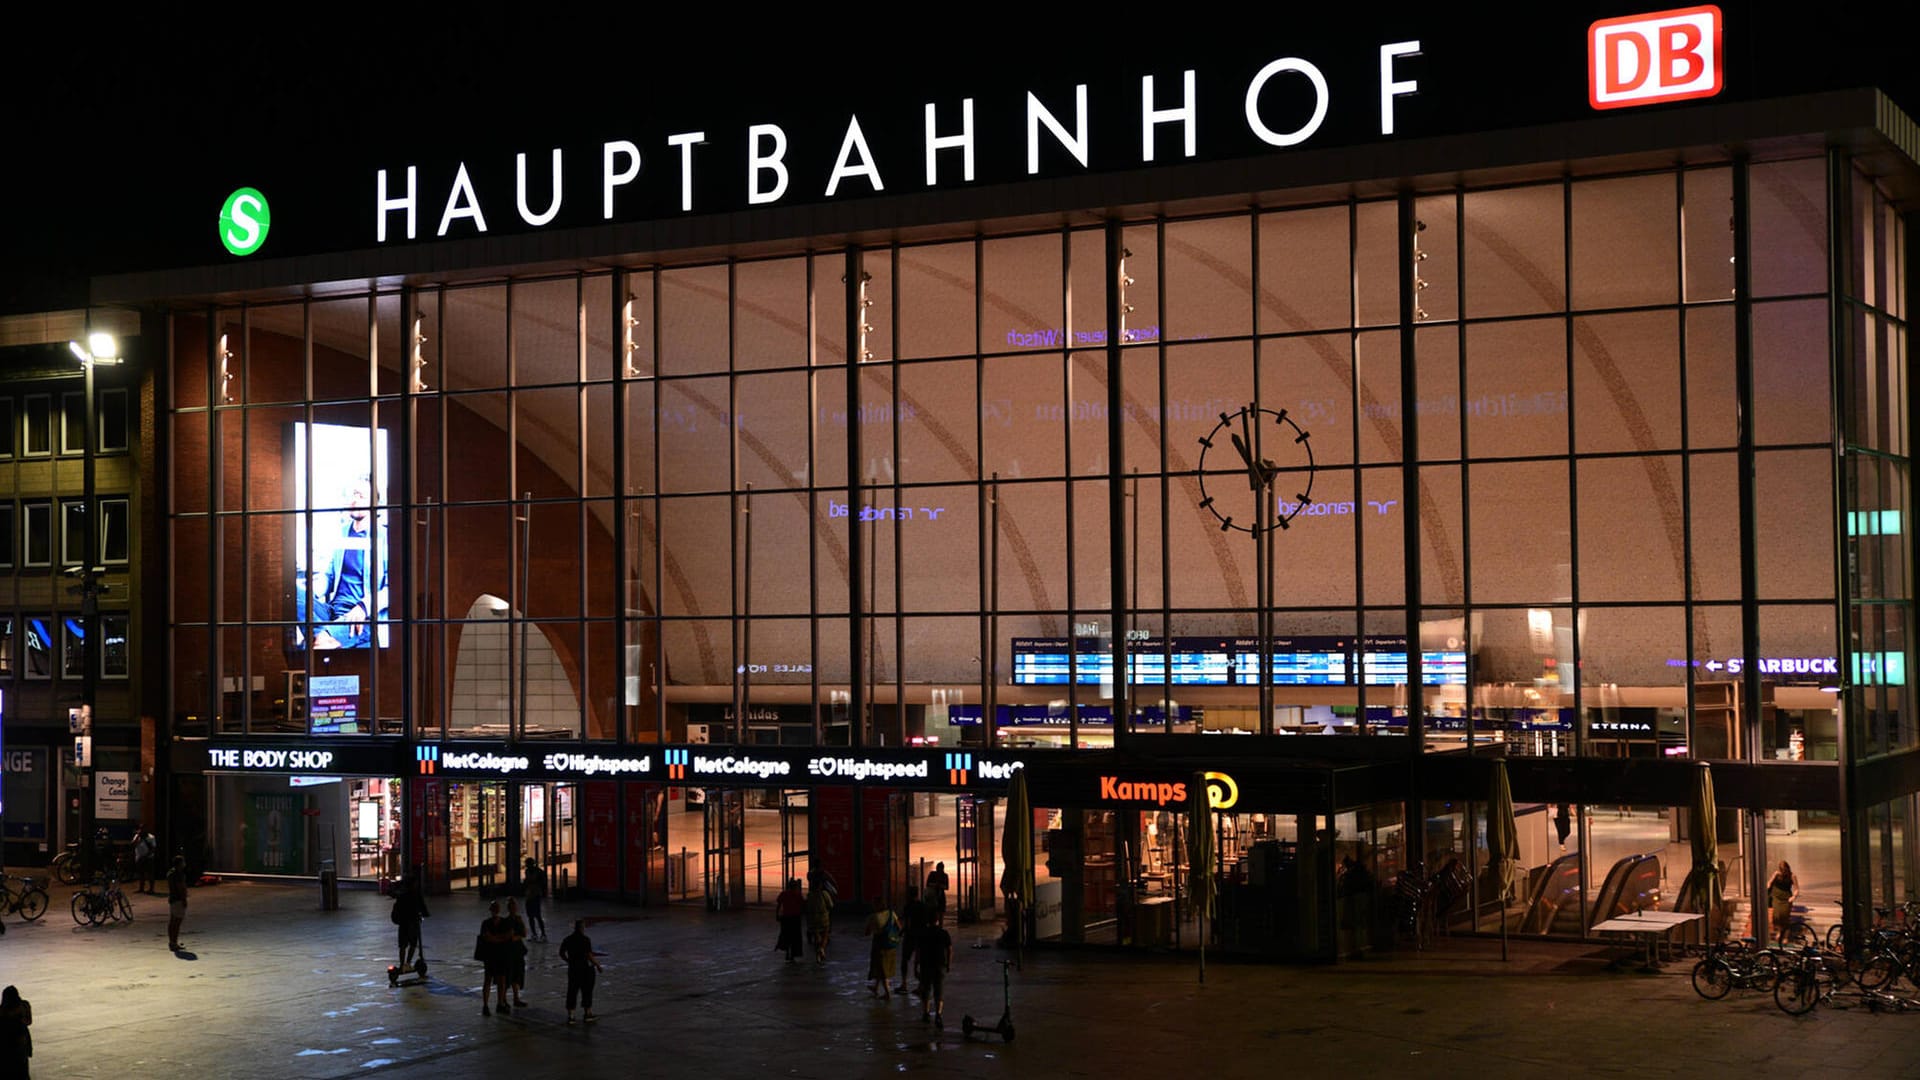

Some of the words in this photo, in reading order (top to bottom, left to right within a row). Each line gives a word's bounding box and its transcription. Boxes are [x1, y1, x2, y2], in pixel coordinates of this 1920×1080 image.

[1605, 23, 1705, 95] DB
[376, 40, 1423, 243] HAUPTBAHNHOF
[227, 195, 262, 249] S
[1727, 657, 1838, 673] SARBUCK
[1591, 721, 1651, 731] ETERNA
[208, 749, 240, 767] THE
[243, 750, 286, 768] BODY
[288, 751, 333, 769] SHOP
[442, 752, 529, 773] NetCologne
[568, 755, 651, 776] Highspeed
[693, 756, 791, 778] NetCologne
[836, 758, 928, 780] Highspeed
[1100, 776, 1187, 806] Kamps
